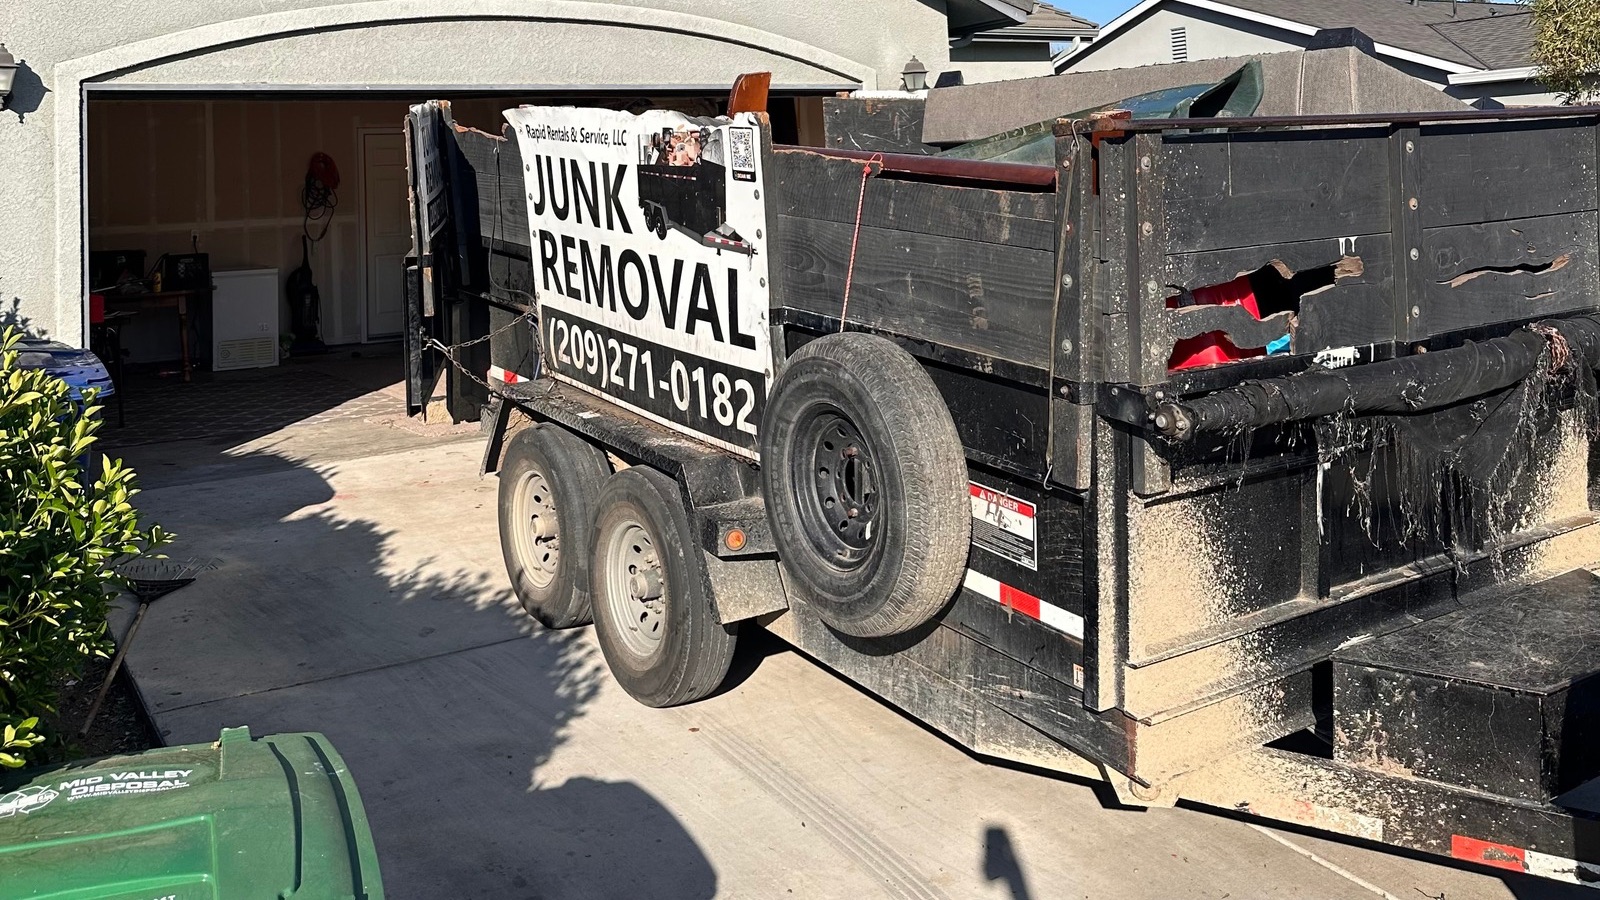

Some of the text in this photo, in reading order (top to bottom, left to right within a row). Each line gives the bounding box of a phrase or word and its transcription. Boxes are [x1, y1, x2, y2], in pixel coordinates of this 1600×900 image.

[525, 124, 627, 147] Rapid Rentals & Service, LLC
[534, 154, 633, 234] JUNK
[539, 229, 756, 351] REMOVAL
[549, 317, 758, 436] (209)271-0182
[987, 492, 1019, 512] DANGER
[59, 769, 194, 791] MID VALLEY
[71, 779, 187, 796] DISPOSAL
